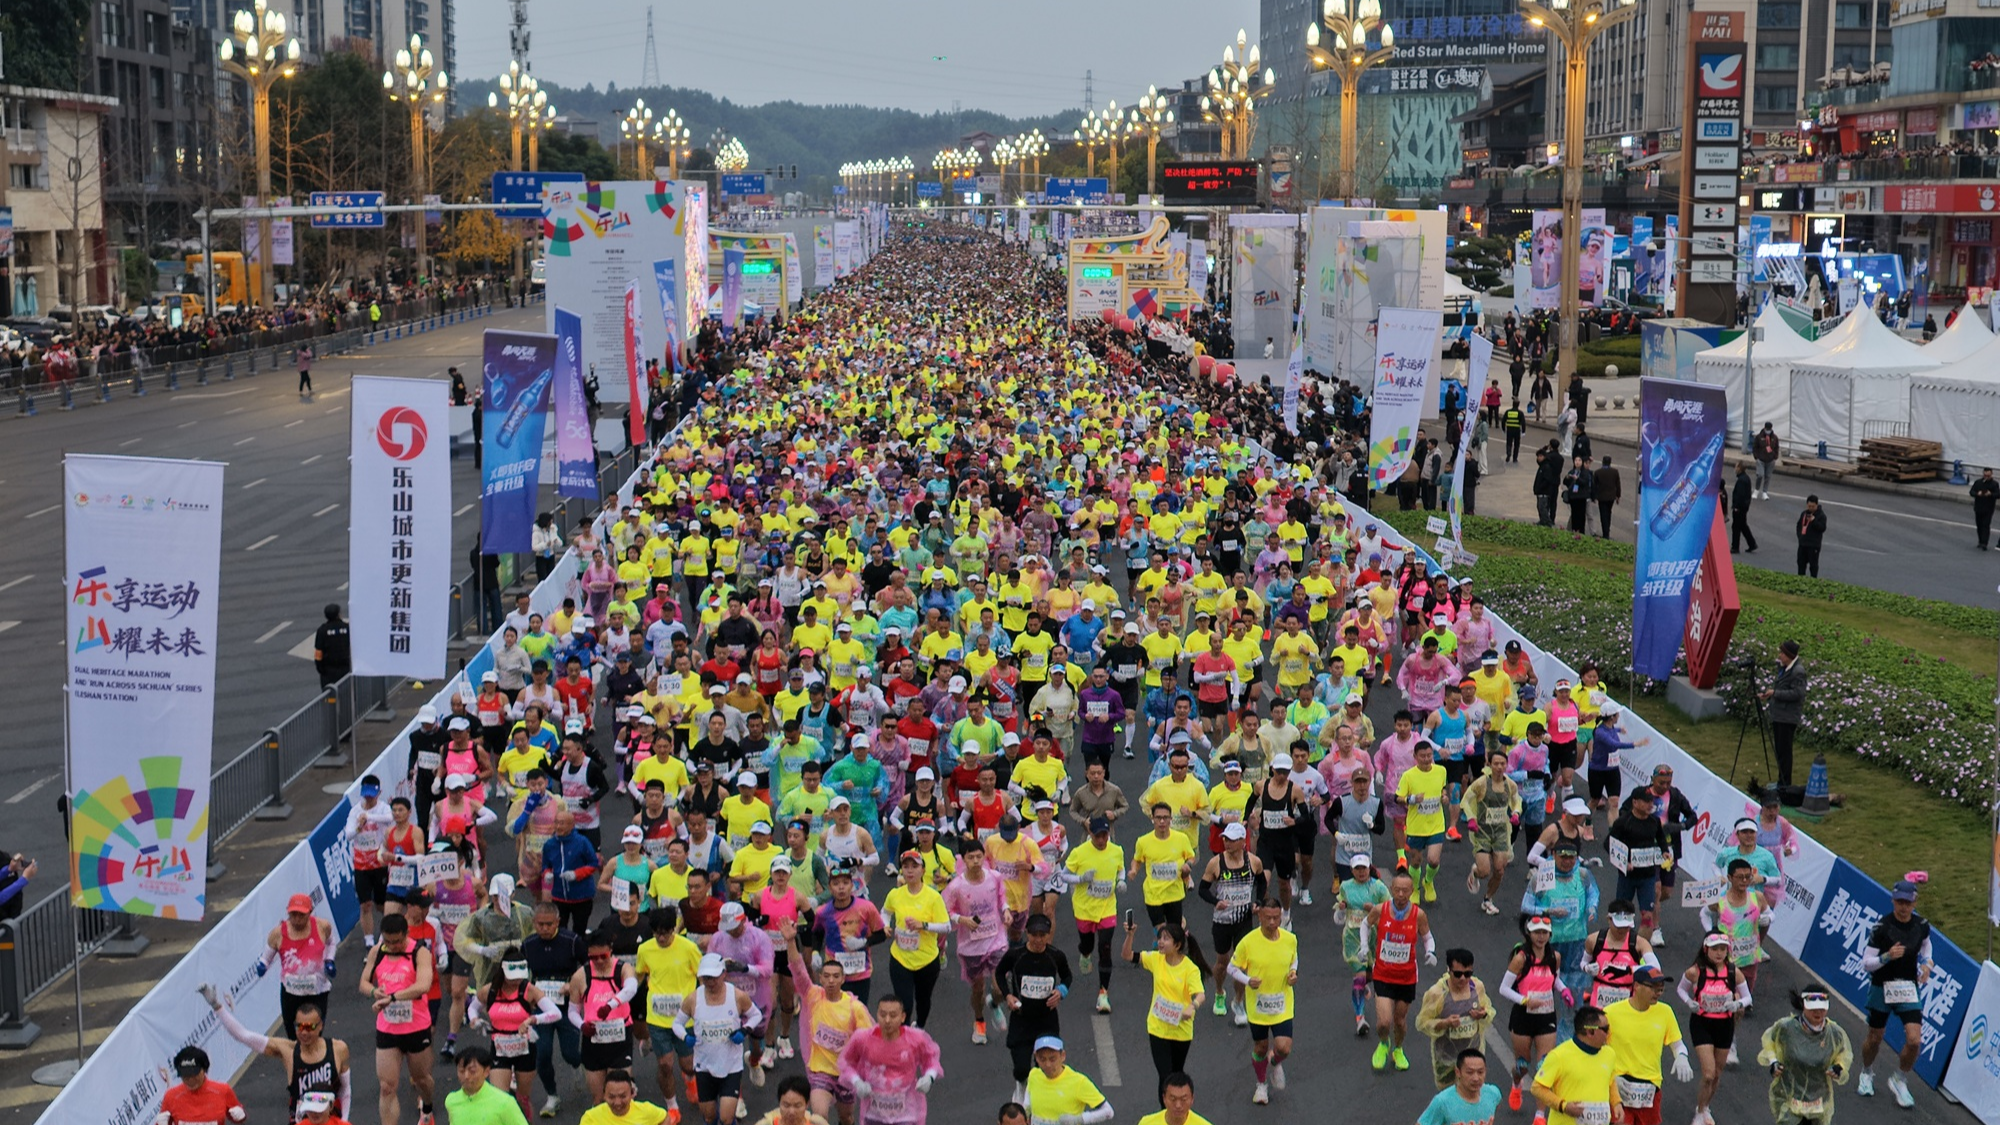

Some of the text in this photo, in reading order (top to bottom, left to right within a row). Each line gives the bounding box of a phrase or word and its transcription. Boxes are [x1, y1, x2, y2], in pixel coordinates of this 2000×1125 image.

[1392, 42, 1546, 58] Red Star Macalline Home
[390, 466, 414, 654] 乐山城市更新集团
[74, 566, 200, 620] 乐享运动
[128, 669, 171, 679] MARATHON
[1696, 888, 1718, 899] 4:30
